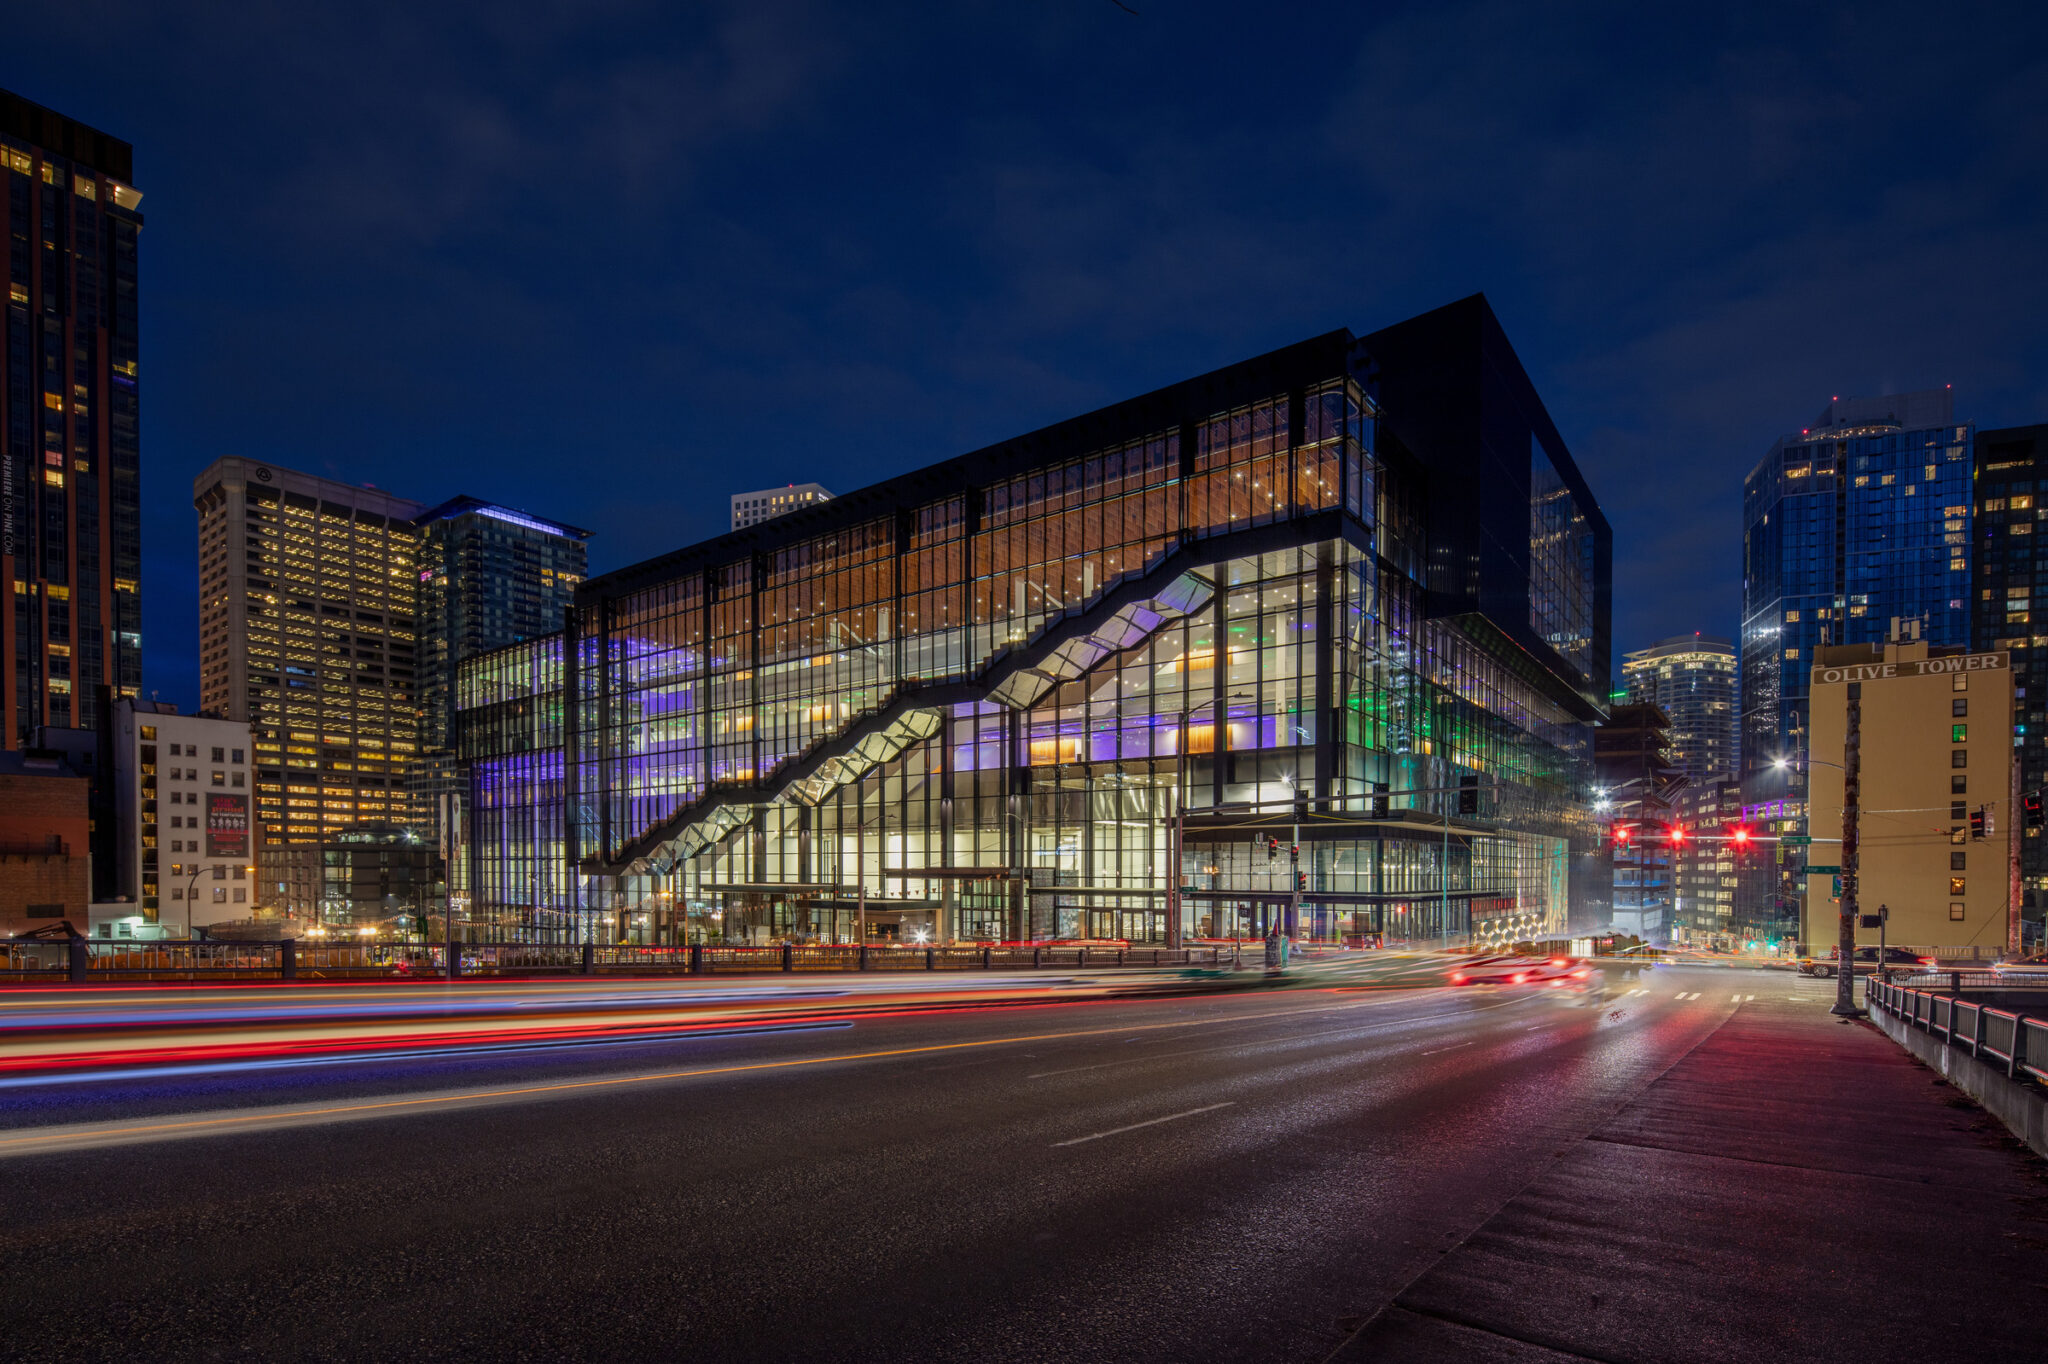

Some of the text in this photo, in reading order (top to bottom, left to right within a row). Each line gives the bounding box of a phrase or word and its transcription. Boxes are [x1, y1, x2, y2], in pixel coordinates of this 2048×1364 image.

[3, 454, 12, 496] PREMIERE
[1823, 655, 1999, 682] OLIVE TOWER
